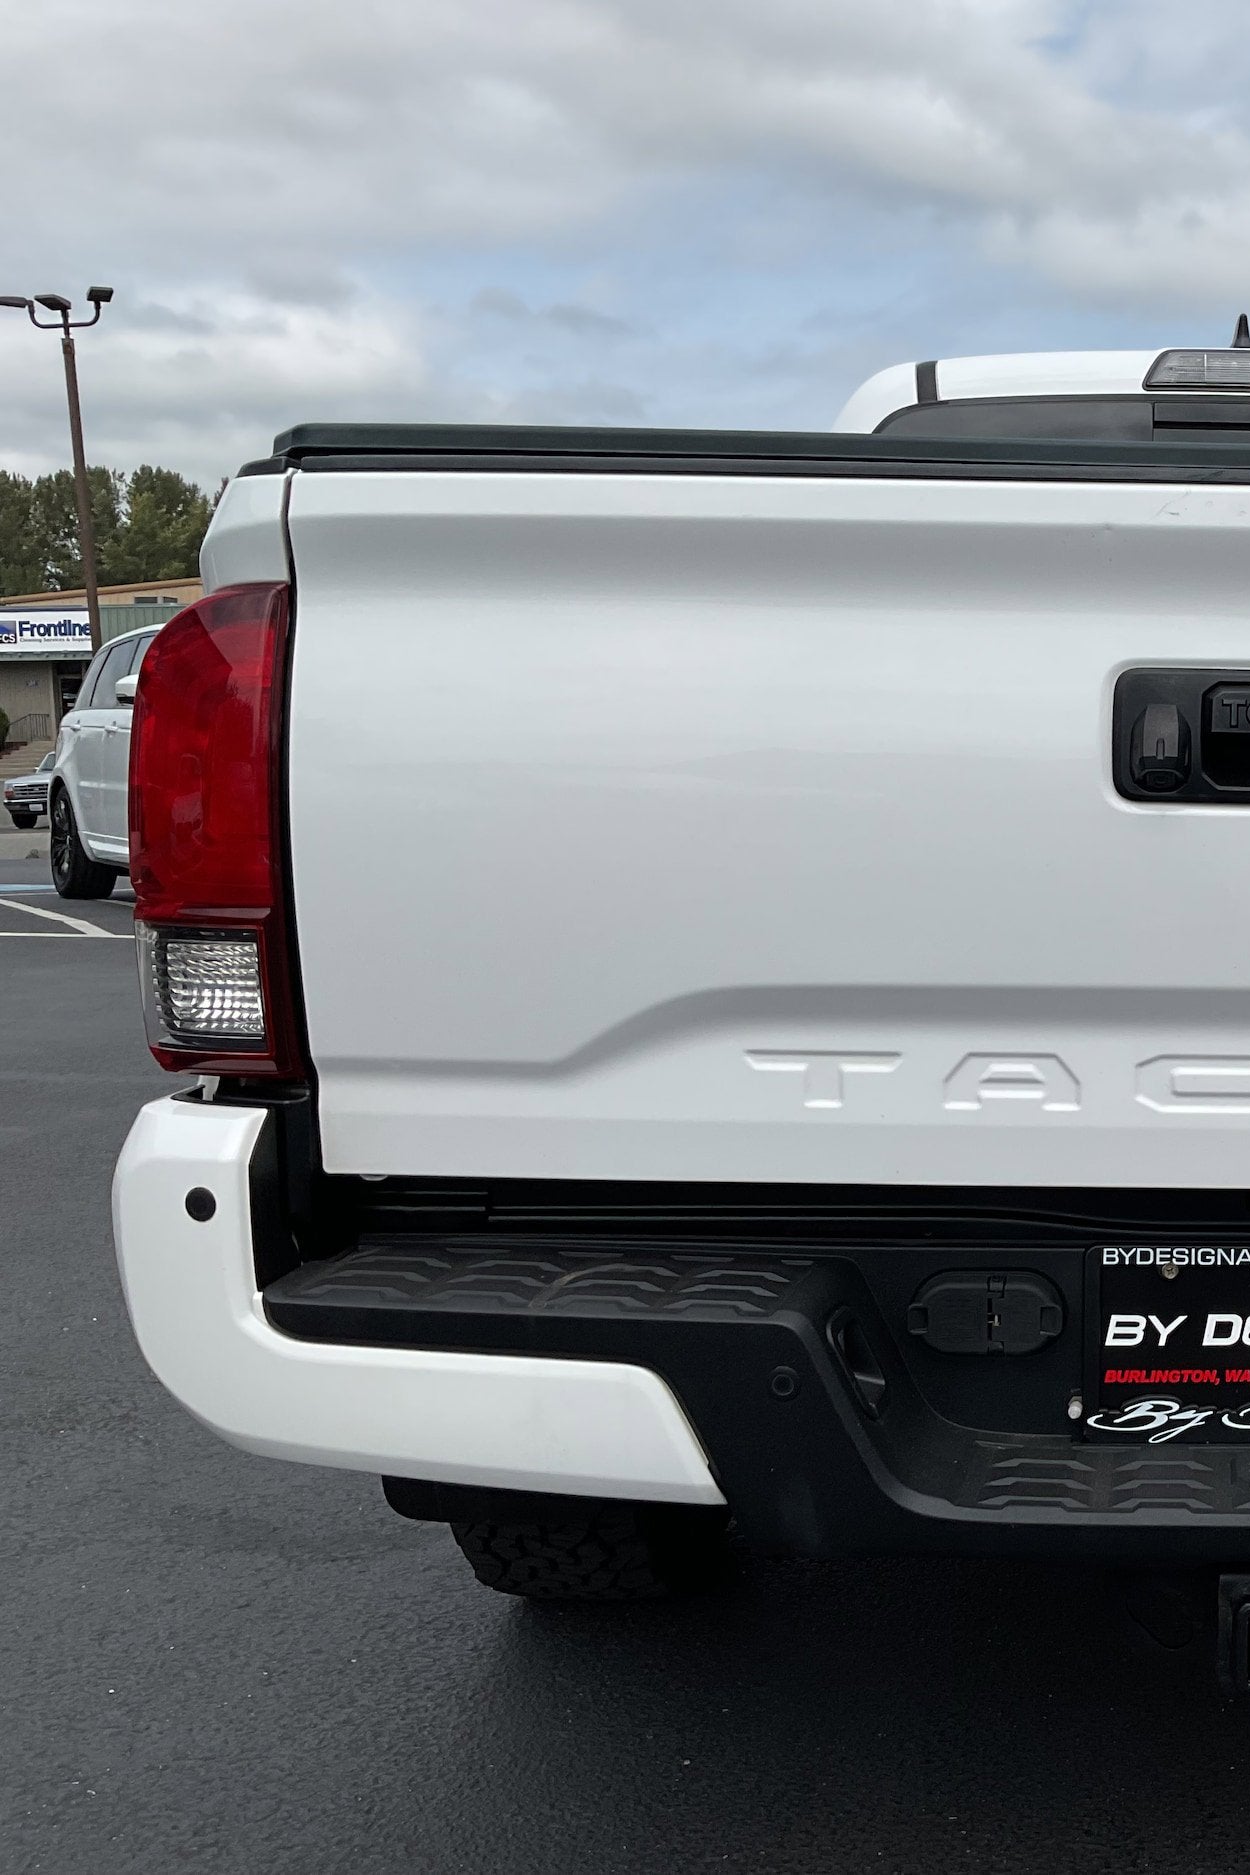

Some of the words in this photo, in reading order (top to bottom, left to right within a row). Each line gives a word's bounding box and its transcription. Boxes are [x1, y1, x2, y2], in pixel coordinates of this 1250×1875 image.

[19, 620, 91, 637] Frontline
[1104, 1314, 1188, 1347] BY
[1104, 1369, 1221, 1385] BURLINGTON,
[1087, 1399, 1215, 1444] By
